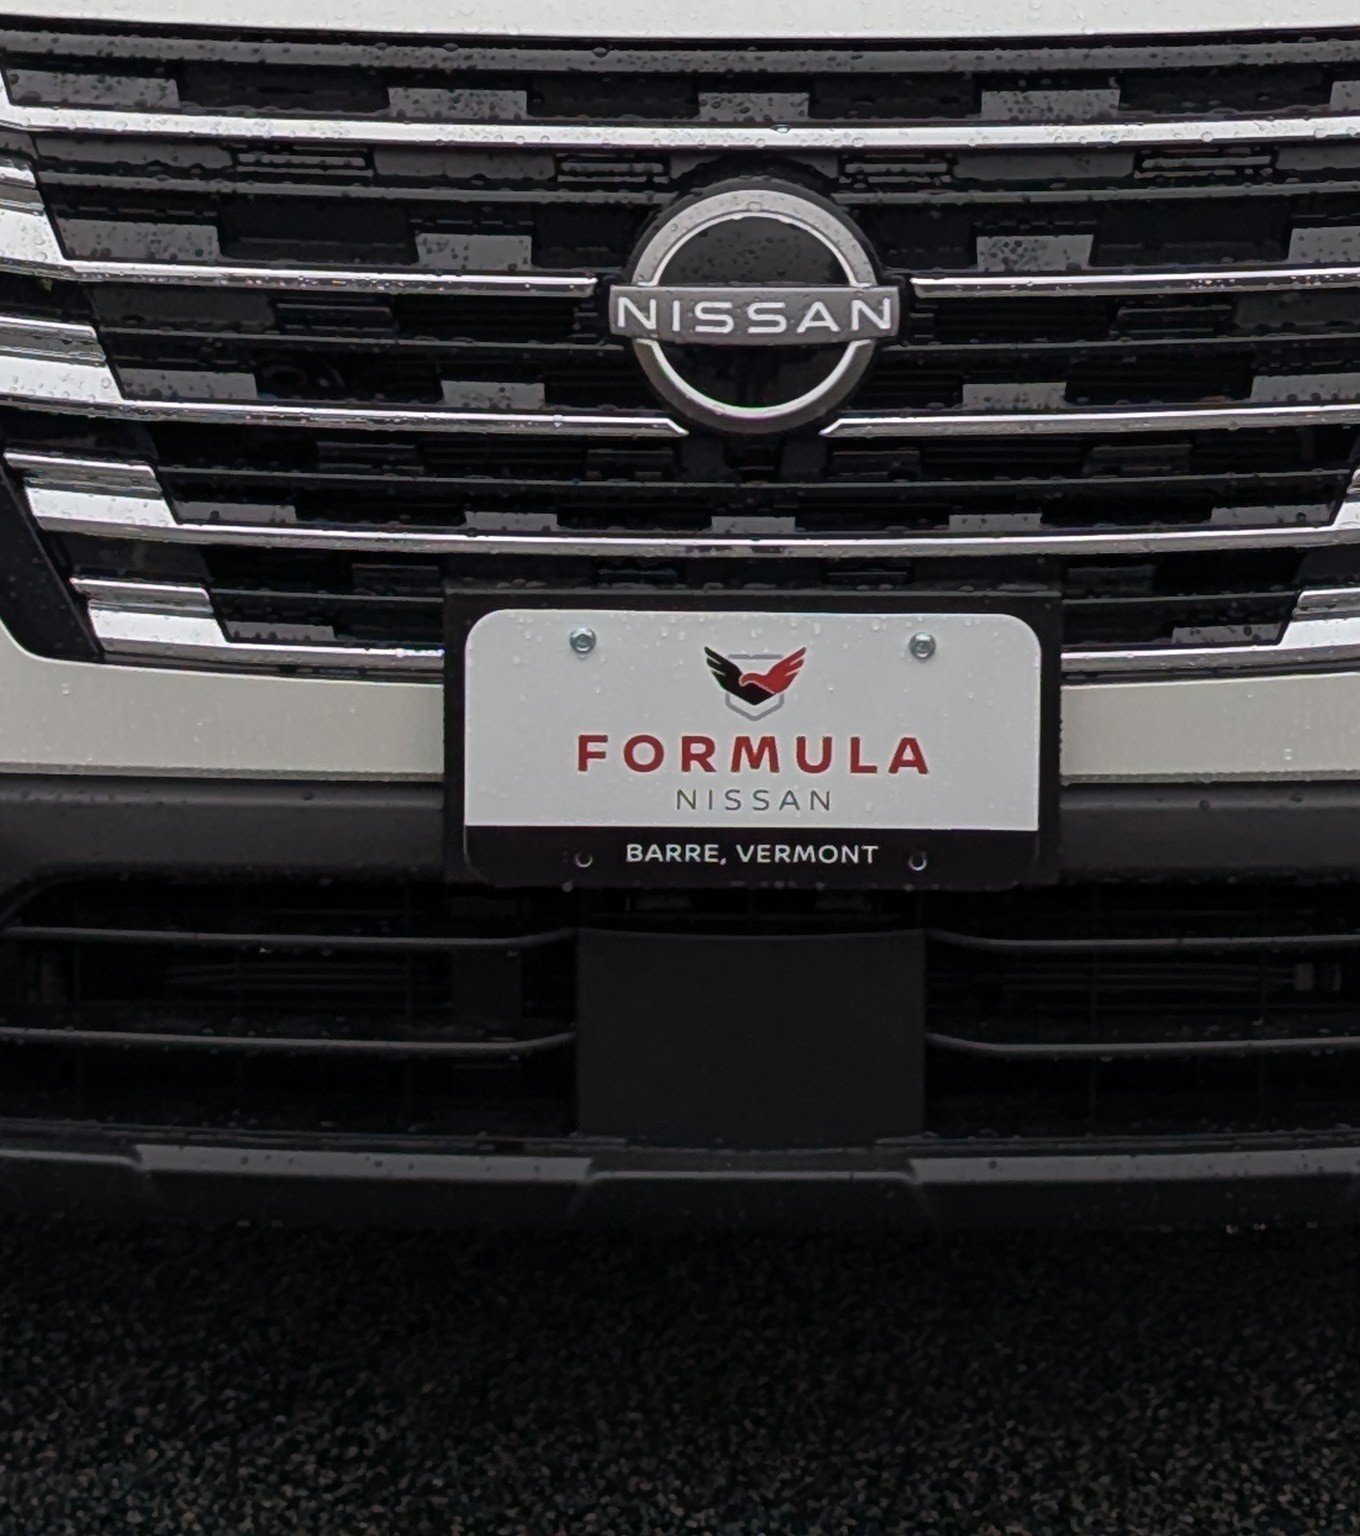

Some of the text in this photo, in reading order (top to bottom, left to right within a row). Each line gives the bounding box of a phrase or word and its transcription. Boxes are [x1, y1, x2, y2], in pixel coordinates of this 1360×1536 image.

[616, 296, 892, 333] NISSAN
[577, 734, 929, 774] FORMULA
[676, 789, 832, 811] NISSAN
[626, 843, 879, 865] BARRE, VERMONT
